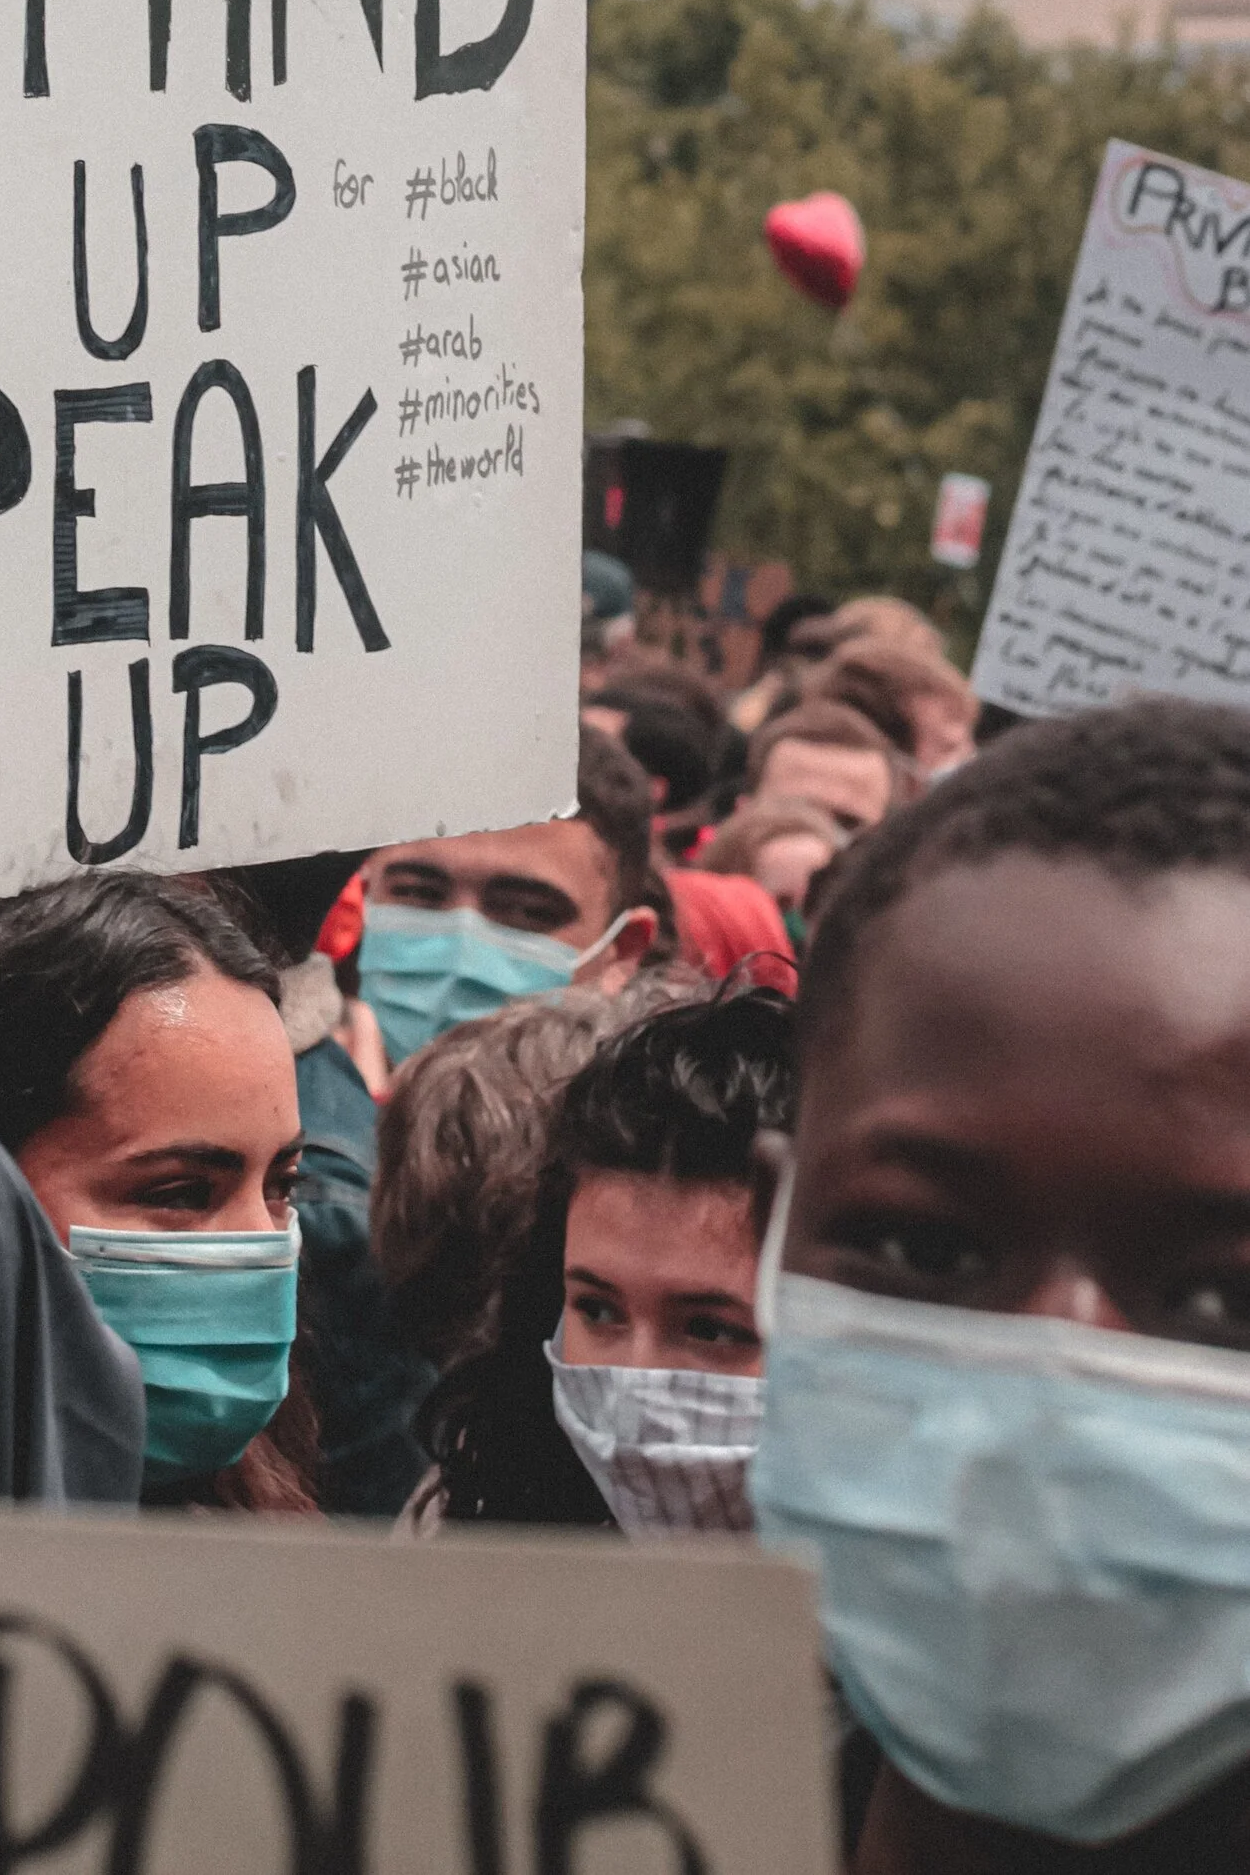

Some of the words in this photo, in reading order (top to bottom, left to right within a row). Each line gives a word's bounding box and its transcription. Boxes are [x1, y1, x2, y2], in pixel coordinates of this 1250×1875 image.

[333, 157, 375, 209] for
[404, 146, 499, 221] #black
[72, 122, 297, 361] UP
[400, 240, 502, 302] #asian
[398, 313, 483, 368] #arab
[398, 361, 541, 438] #minorities
[64, 643, 279, 866] UP
